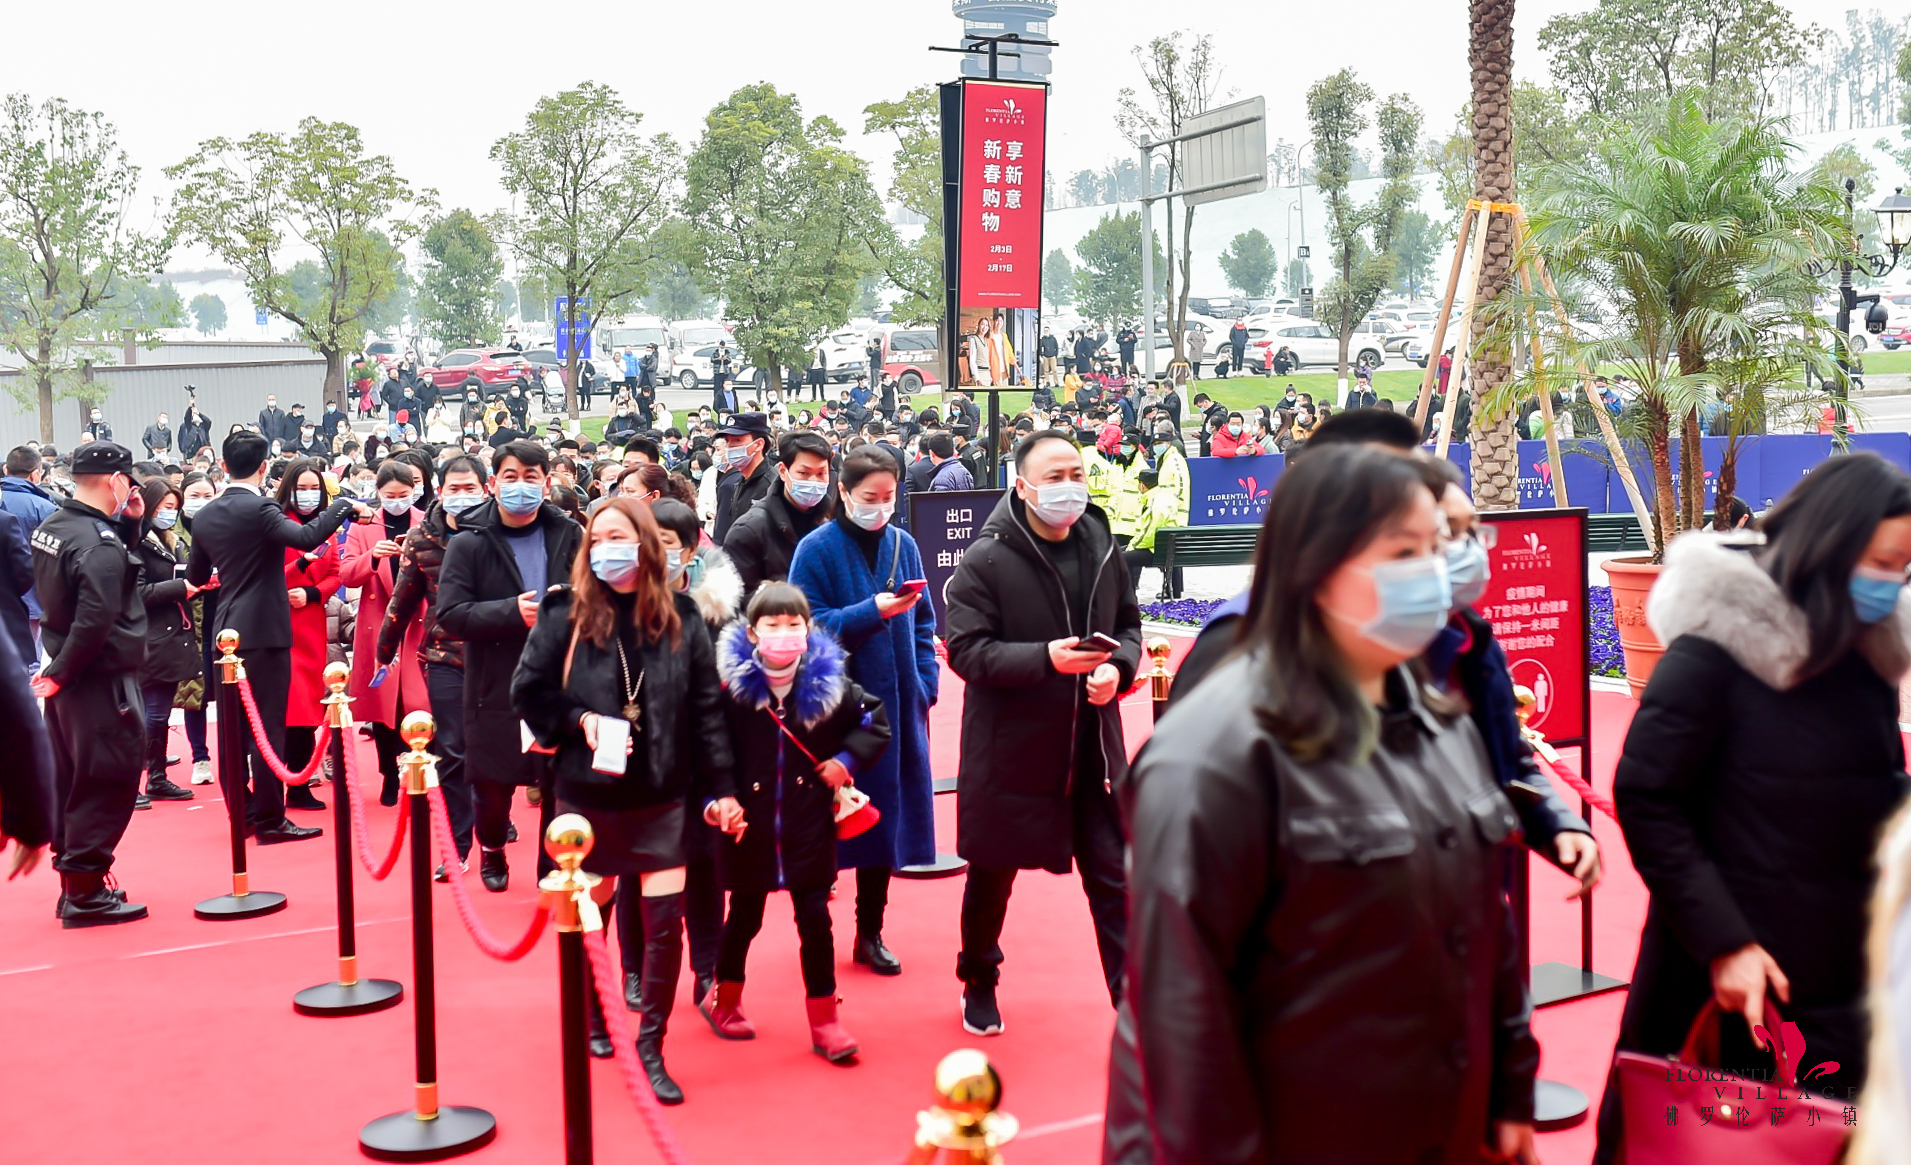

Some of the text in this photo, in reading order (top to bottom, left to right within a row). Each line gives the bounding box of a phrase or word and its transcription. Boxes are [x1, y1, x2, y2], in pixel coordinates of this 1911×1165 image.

[1004, 140, 1024, 210] 享新意
[981, 138, 1002, 232] 新春购物
[990, 245, 1013, 254] 2月3日
[987, 263, 1013, 273] 2月17日
[1207, 493, 1249, 502] FLORENTIA
[1223, 498, 1272, 506] VILLAG
[946, 509, 973, 523] 出口
[946, 528, 973, 539] EXIT
